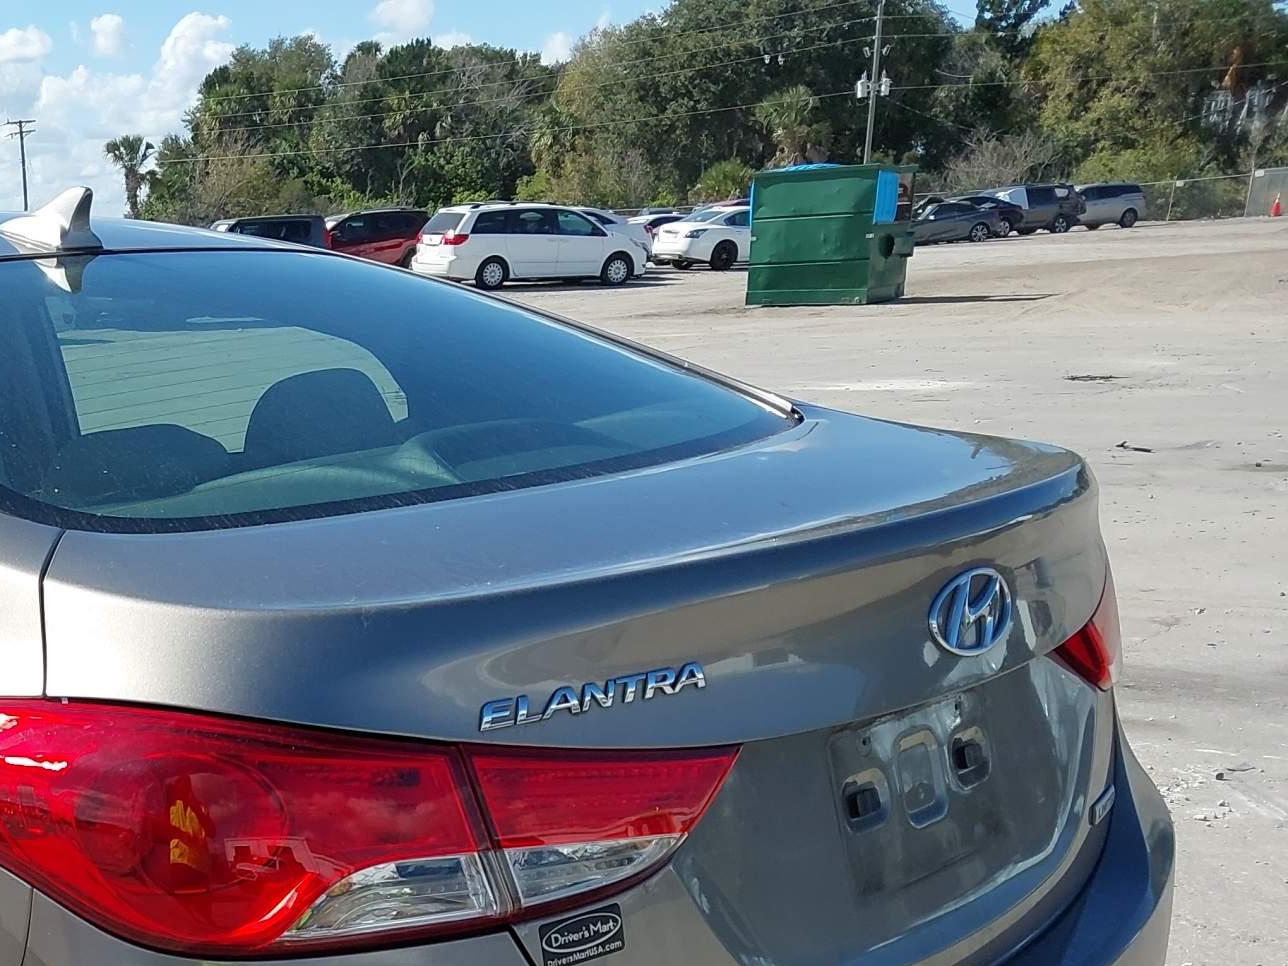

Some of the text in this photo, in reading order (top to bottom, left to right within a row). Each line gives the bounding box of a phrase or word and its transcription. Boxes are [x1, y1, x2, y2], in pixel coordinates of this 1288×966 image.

[479, 661, 706, 731] ELANTRA
[550, 919, 615, 948] Driver's Mart
